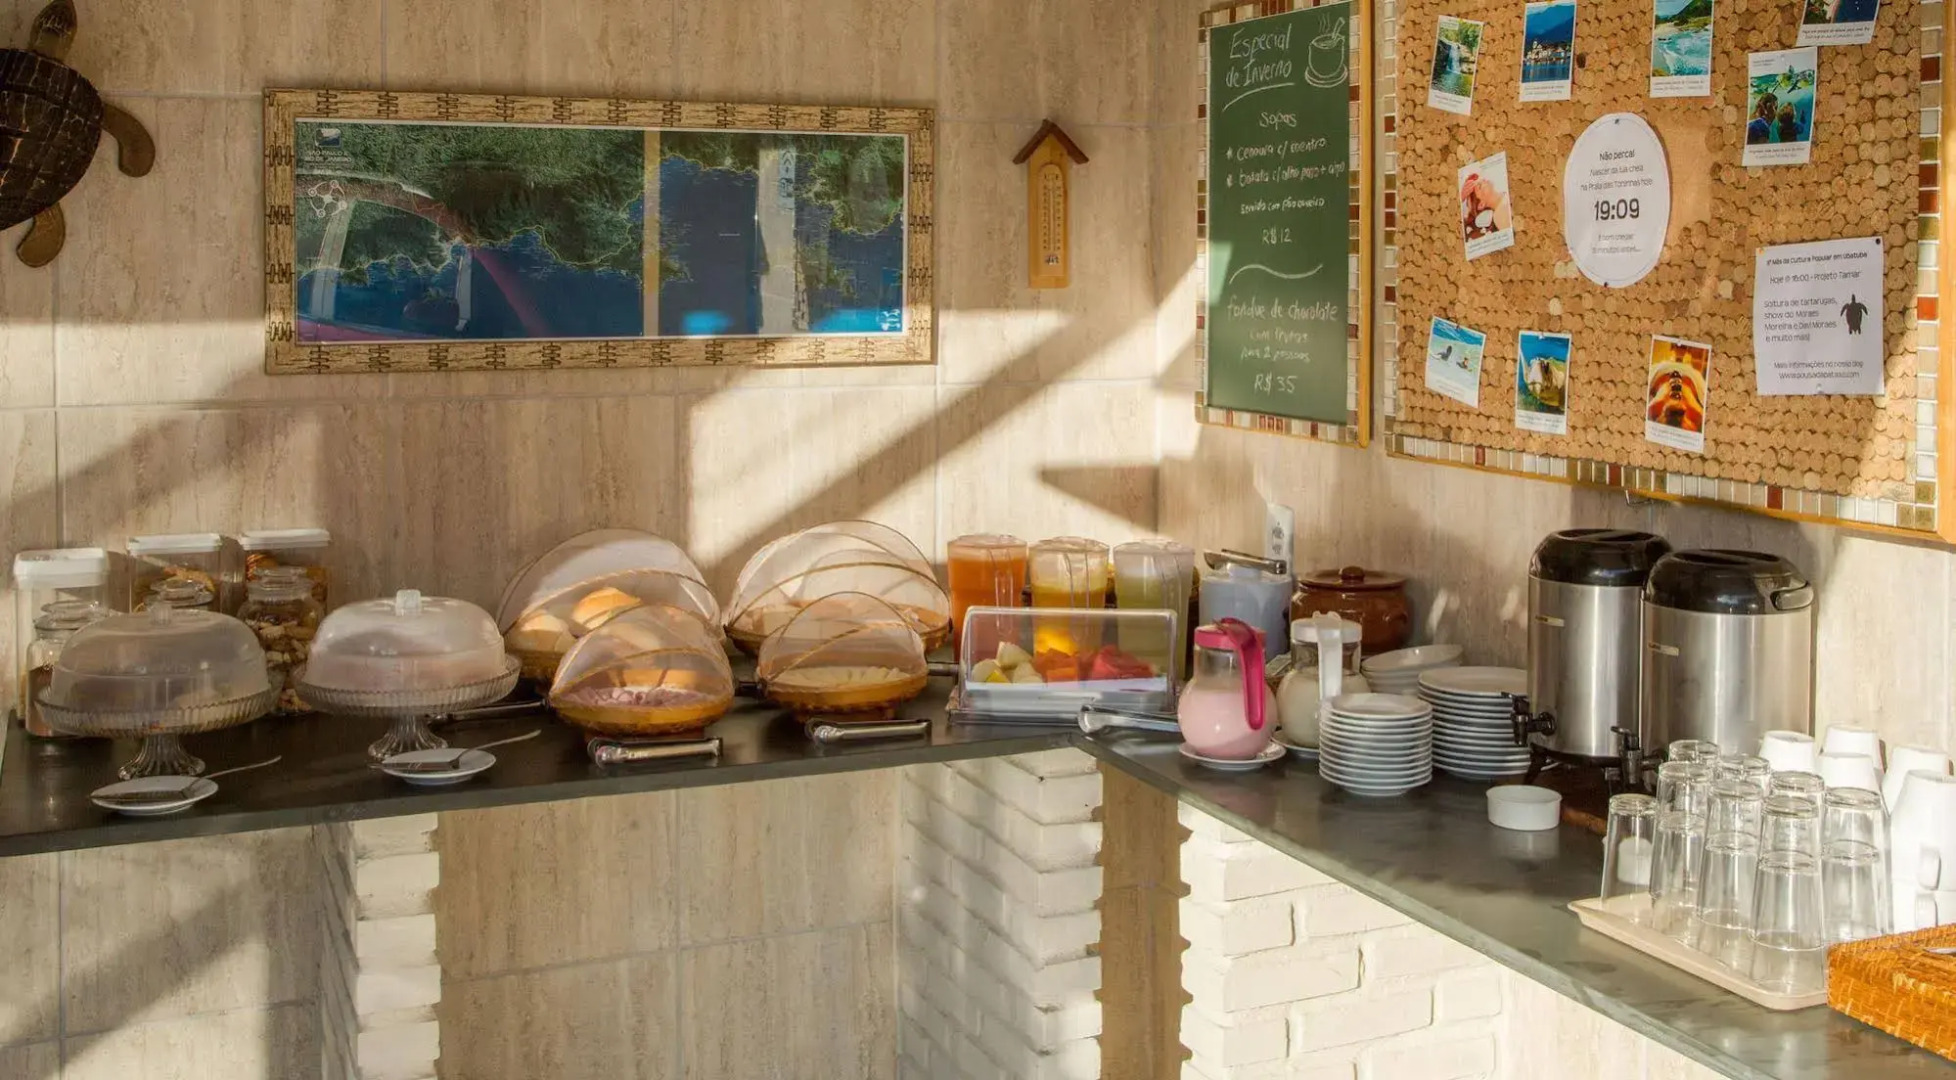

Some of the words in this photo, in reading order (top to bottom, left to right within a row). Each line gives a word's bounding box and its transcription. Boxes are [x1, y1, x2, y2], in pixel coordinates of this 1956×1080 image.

[1230, 23, 1293, 61] Especial
[1226, 66, 1240, 87] de
[1243, 59, 1293, 87] Inverno
[1260, 111, 1297, 130] Sopas
[1277, 140, 1288, 159] c/
[1599, 151, 1613, 162] Não
[1613, 149, 1636, 161] perca!
[1590, 167, 1610, 176] Nascer
[1629, 164, 1644, 173] cheia
[1588, 181, 1602, 191] Praia
[1594, 197, 1640, 222] 19:09
[1790, 255, 1811, 264] Cultura
[1812, 253, 1832, 263] Popular
[1833, 253, 1842, 262] em
[1843, 251, 1868, 261] Ubatuba
[1769, 275, 1784, 285] Hoje
[1814, 271, 1838, 283] Projeto
[1839, 269, 1861, 279] Tamar
[1270, 297, 1284, 319] de
[1763, 299, 1790, 309] Soltura
[1790, 299, 1799, 307] de
[1764, 311, 1784, 320] show
[1784, 310, 1794, 319] do
[1796, 309, 1820, 318] Moraes
[1764, 321, 1793, 331] Moreira
[1813, 319, 1837, 330] Moraes
[1771, 333, 1794, 343] muito
[1263, 345, 1271, 358] 2
[1254, 371, 1273, 396] R$
[1276, 375, 1299, 394] 35
